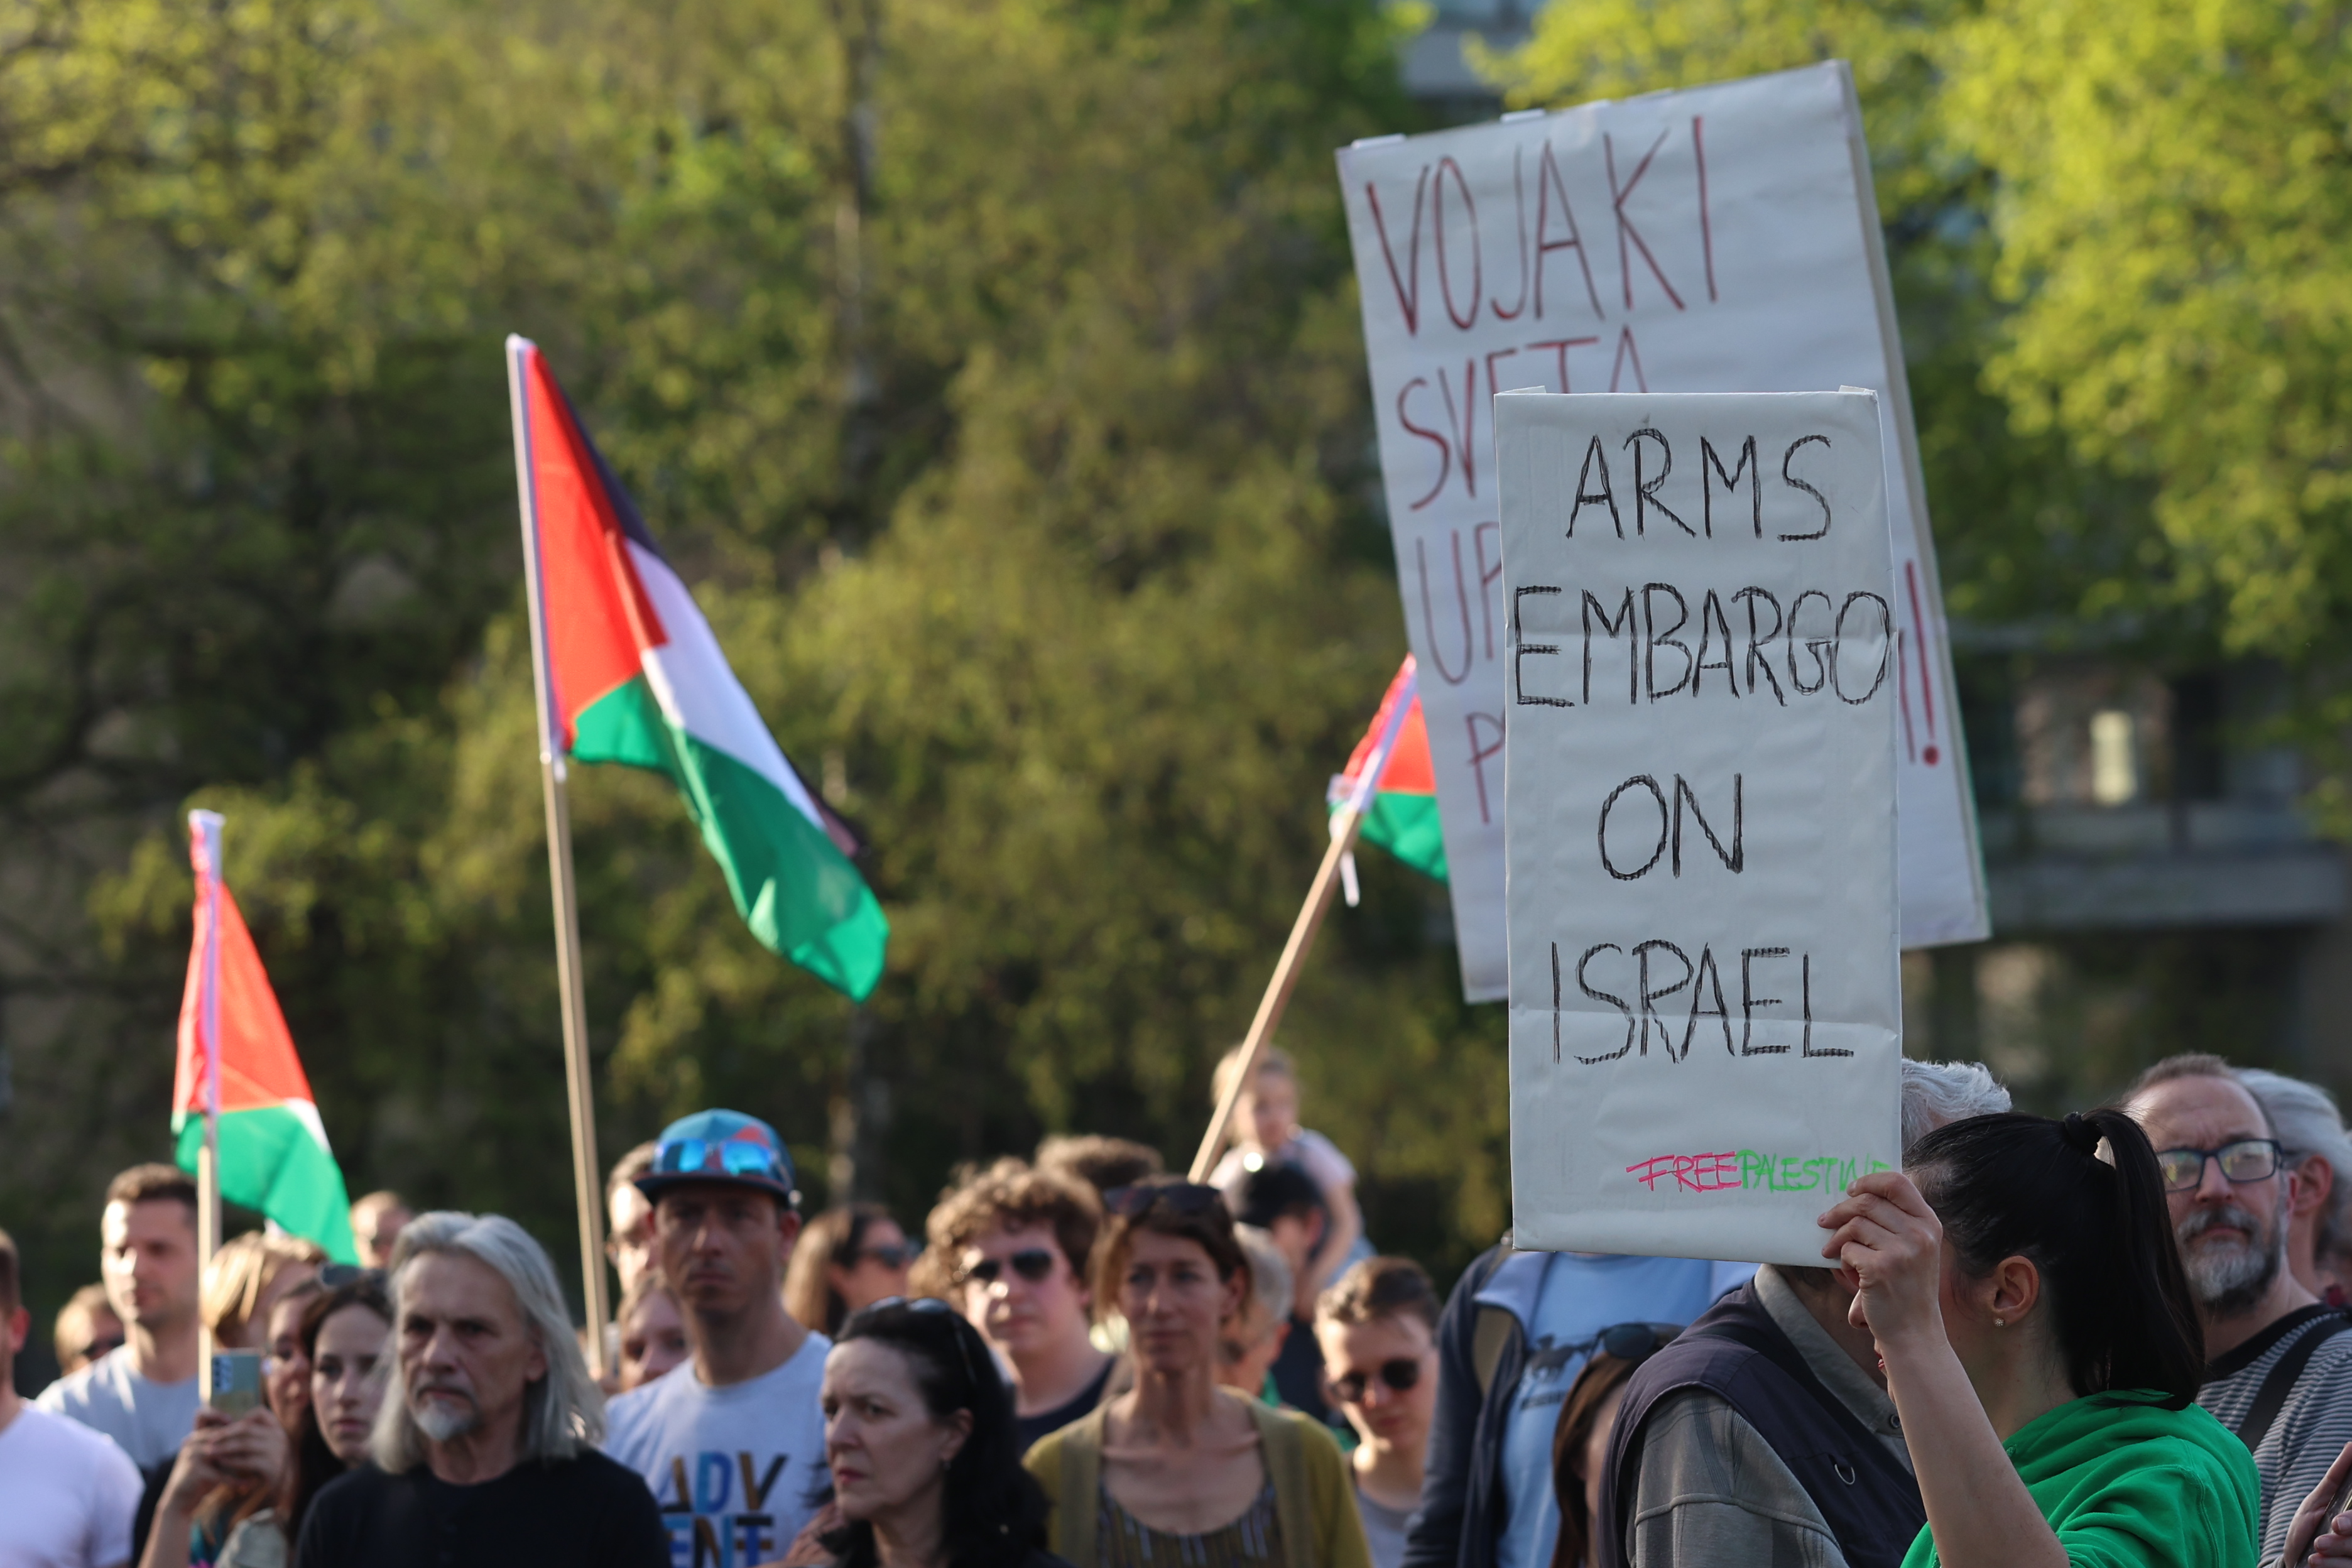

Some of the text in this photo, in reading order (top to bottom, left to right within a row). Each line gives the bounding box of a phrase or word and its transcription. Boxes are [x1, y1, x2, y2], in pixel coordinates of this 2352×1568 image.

[1366, 115, 1718, 337] VOJAKI
[1564, 427, 1832, 542] ARMS
[1512, 582, 1891, 707] EMBARGO
[1598, 772, 1745, 881] ON
[1551, 939, 1854, 1065] ISRAEL
